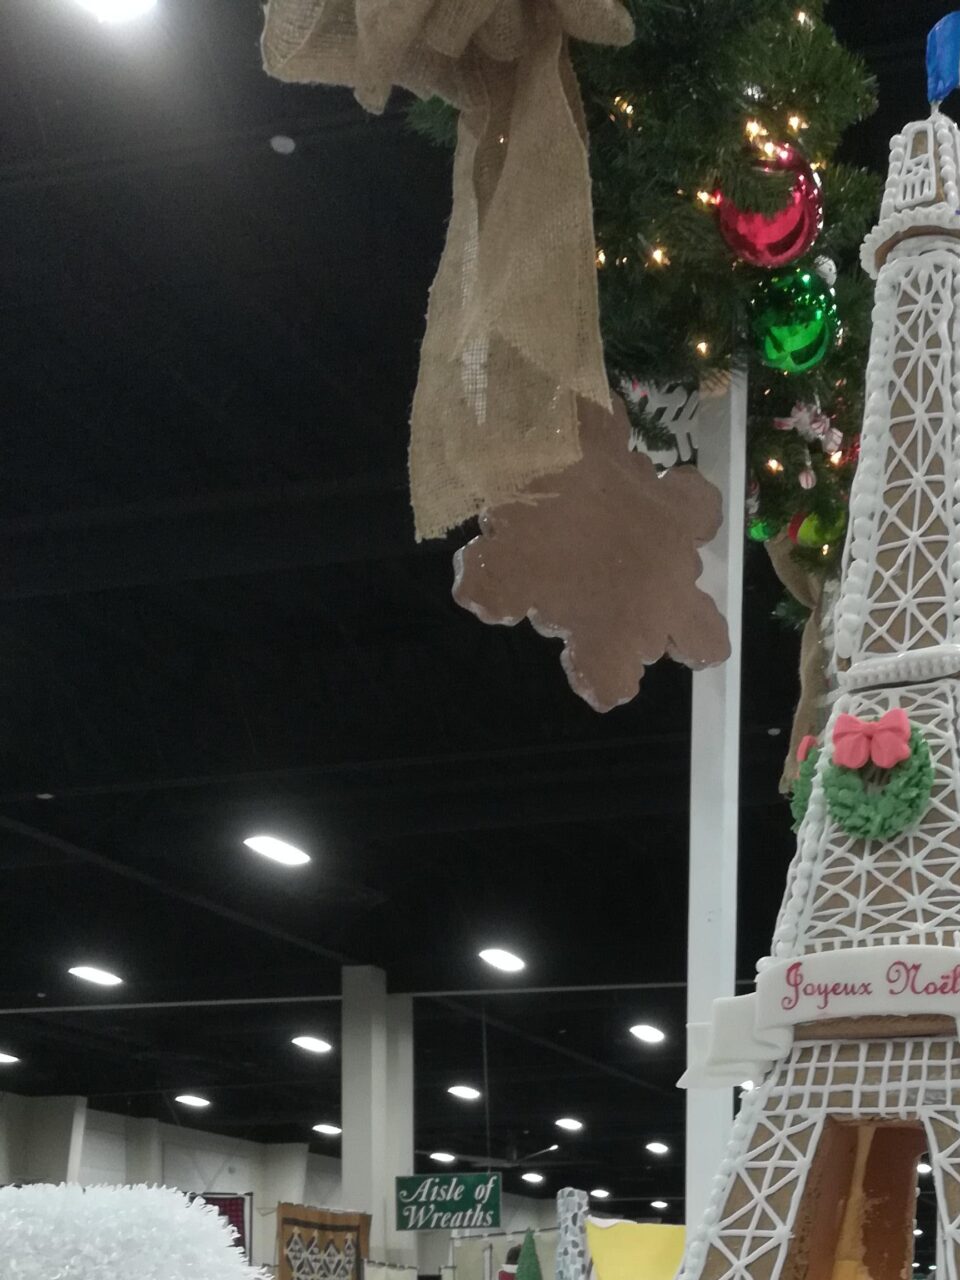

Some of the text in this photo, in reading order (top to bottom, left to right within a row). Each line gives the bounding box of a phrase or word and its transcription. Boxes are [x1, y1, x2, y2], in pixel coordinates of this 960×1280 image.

[781, 961, 872, 1010] Joyeux
[400, 1175, 498, 1204] Aisle of
[403, 1203, 494, 1229] Wreaths
